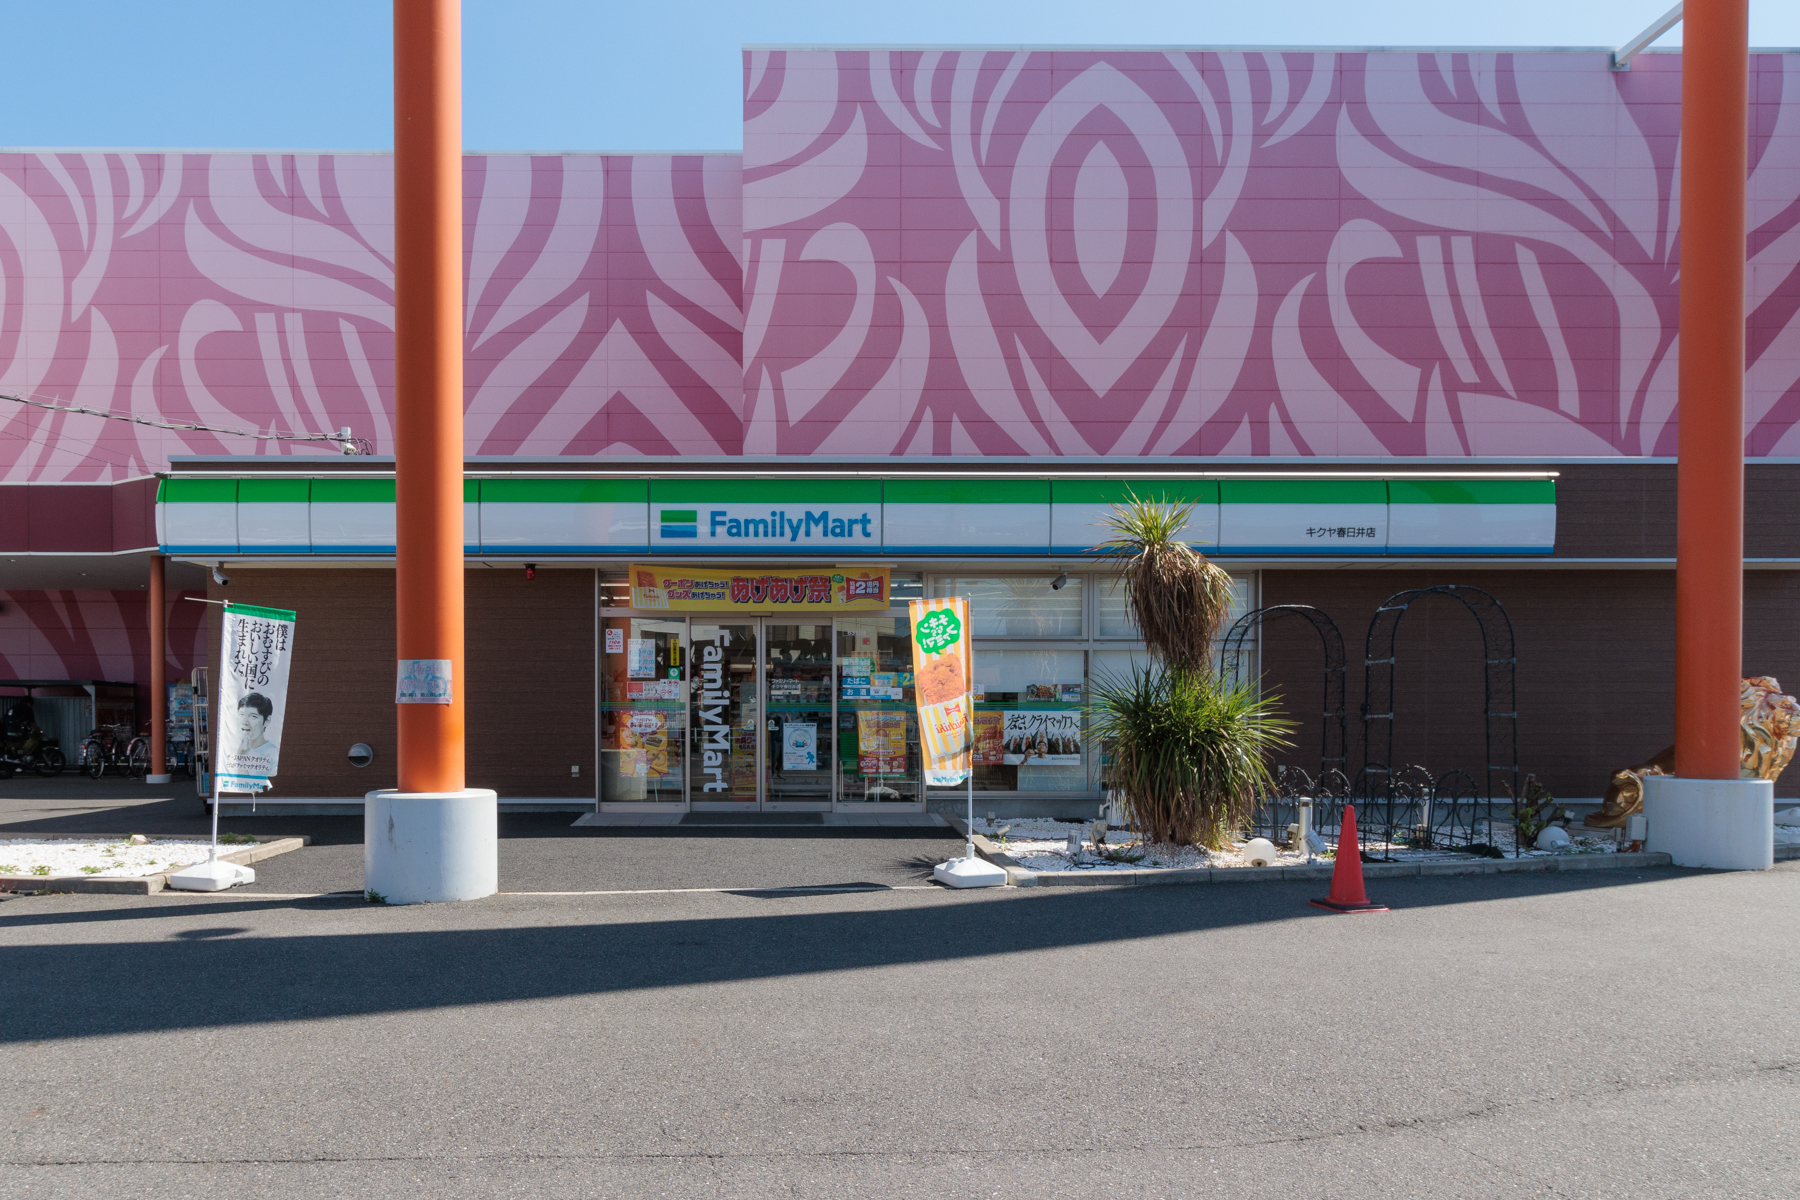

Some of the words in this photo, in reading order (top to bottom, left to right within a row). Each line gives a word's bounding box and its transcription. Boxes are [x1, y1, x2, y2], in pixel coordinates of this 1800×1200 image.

[710, 510, 872, 542] FamilyMart
[1306, 527, 1376, 538] キクヤ春日井店
[730, 575, 831, 603] あげあげ祭
[856, 581, 867, 594] 2
[233, 618, 250, 678] 生まれた。
[275, 623, 289, 652] 僕は
[244, 619, 263, 690] おいしい国に
[257, 621, 276, 687] おむすびの
[698, 629, 730, 792] FamilyMart
